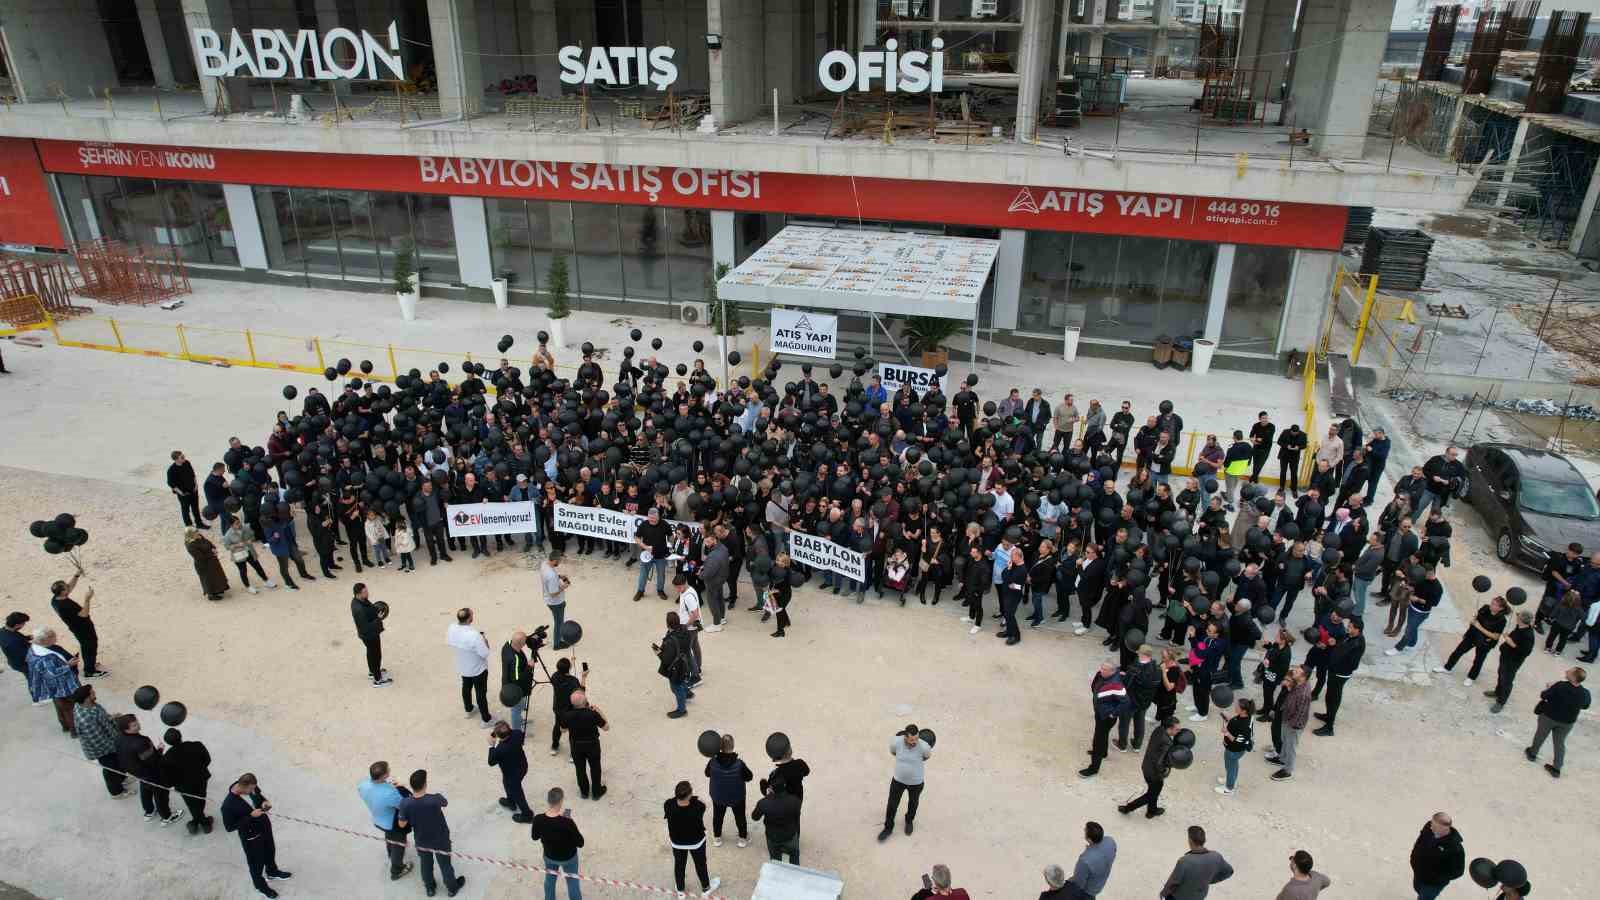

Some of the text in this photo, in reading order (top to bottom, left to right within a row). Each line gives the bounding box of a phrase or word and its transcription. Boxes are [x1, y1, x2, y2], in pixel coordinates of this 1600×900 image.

[193, 20, 944, 93] BABYLON SATIŞ OFİSİ
[419, 156, 559, 189] BABYLON
[570, 162, 664, 202] SATIŞ
[1040, 190, 1183, 219] ATIŞ YAPI
[1207, 200, 1281, 218] 444 90 16
[775, 328, 832, 343] ATIŞ YAPI
[884, 367, 940, 387] BURSA
[558, 507, 628, 527] Smart Evler
[793, 534, 861, 566] BABYLON
